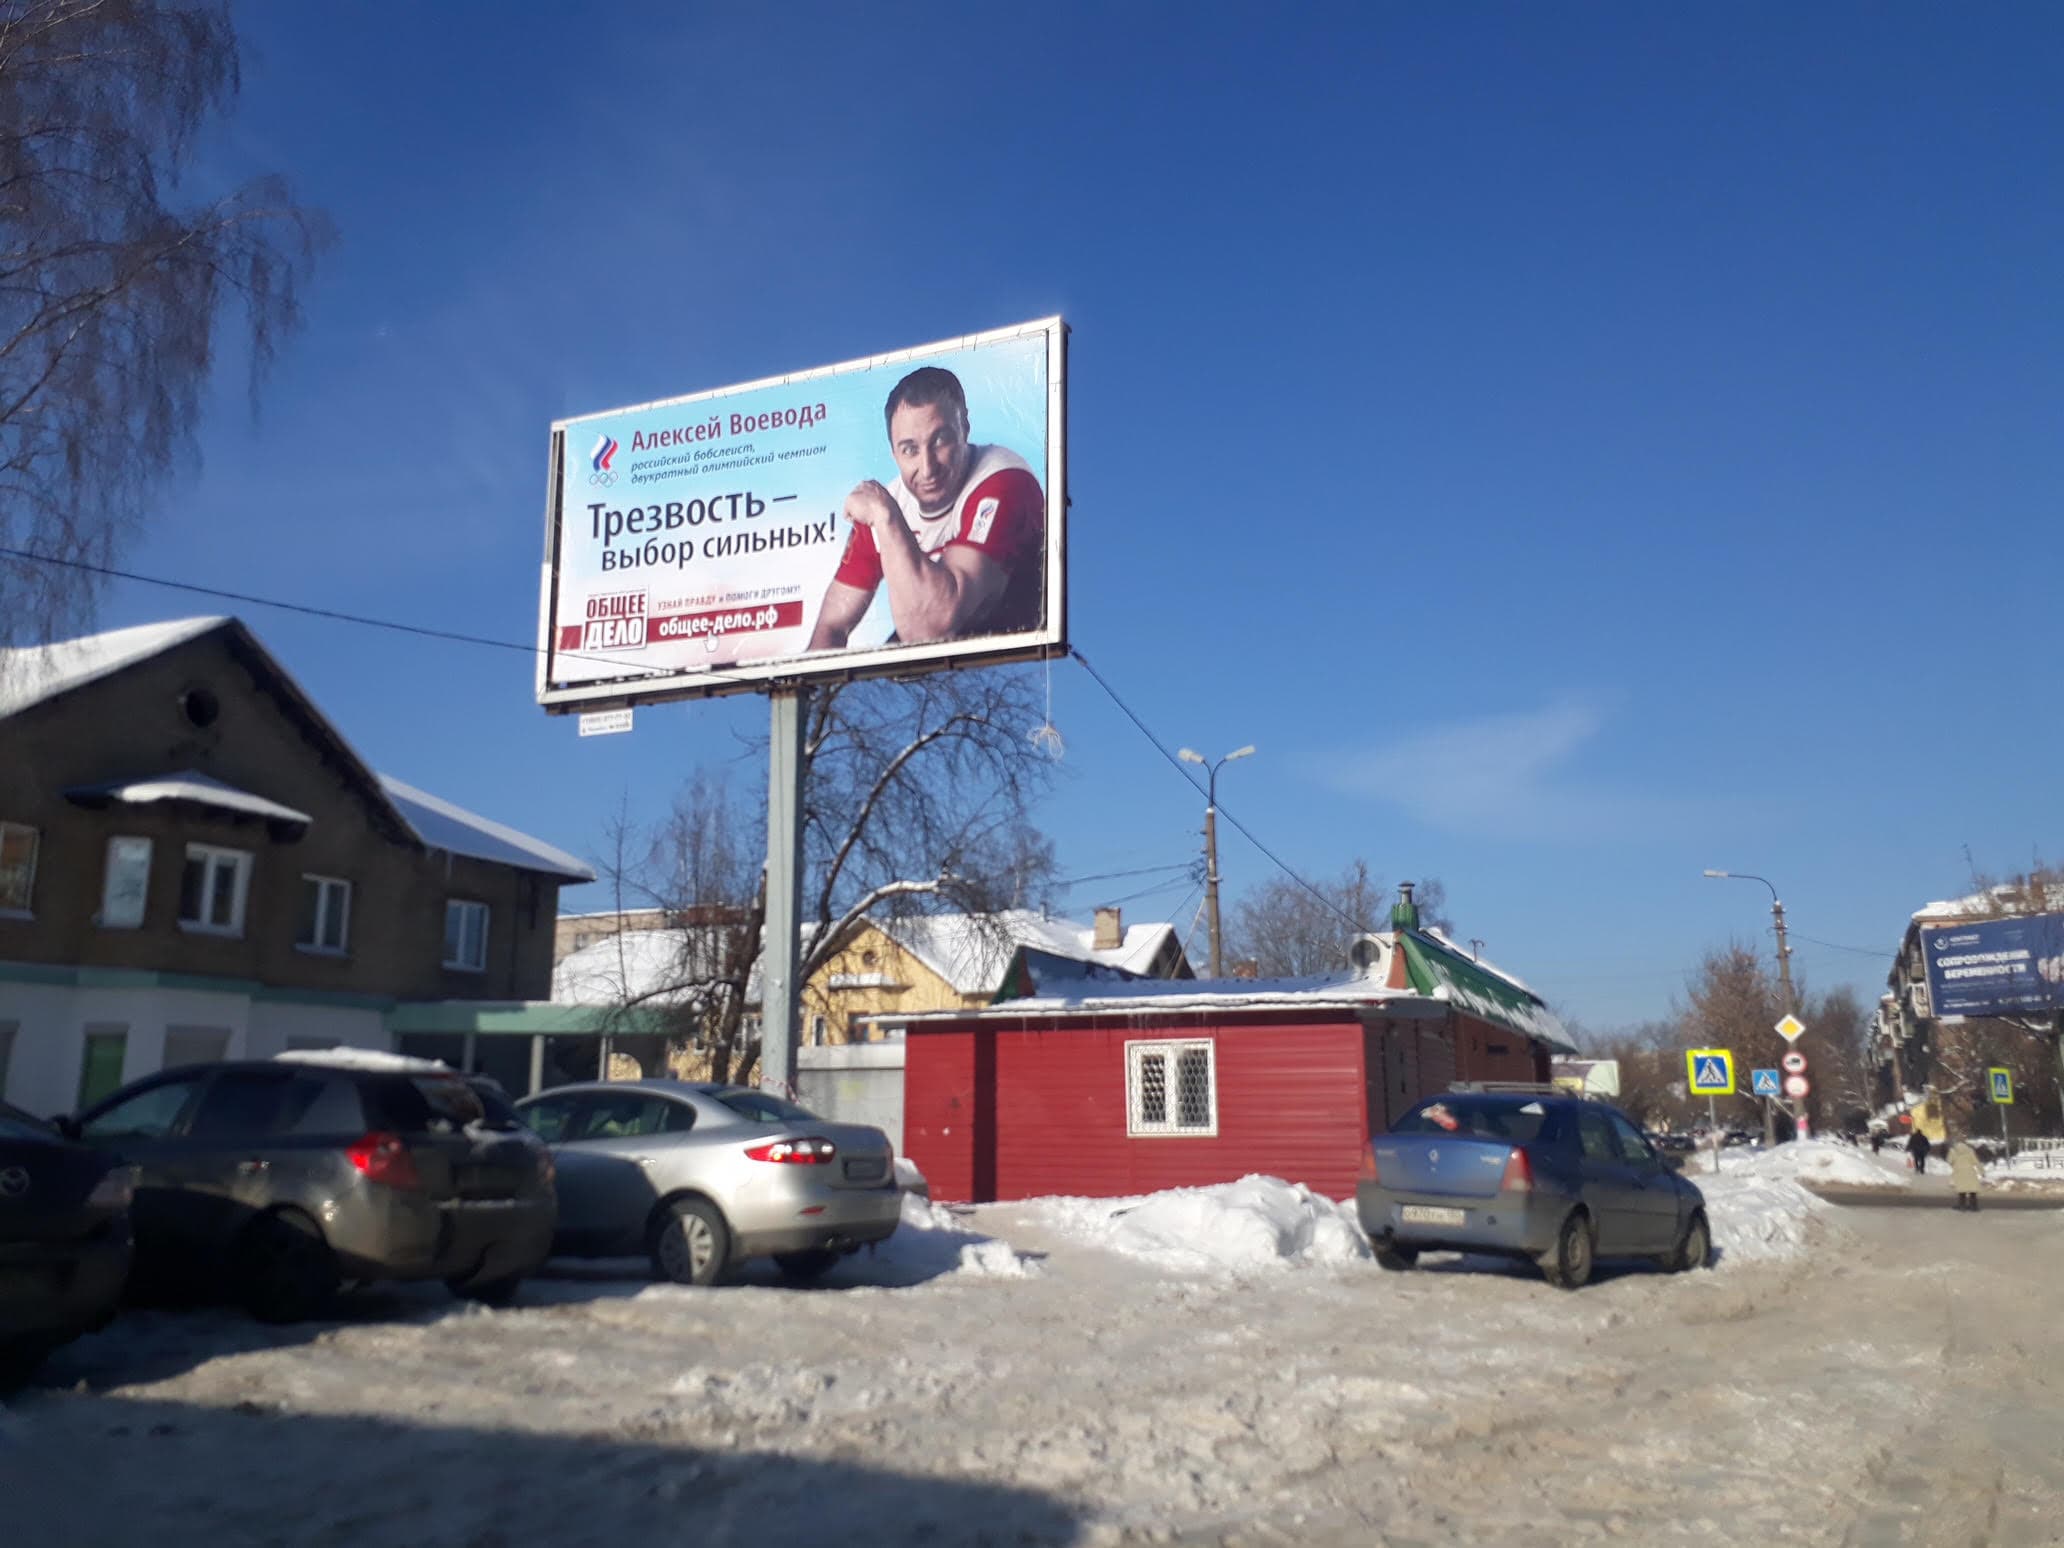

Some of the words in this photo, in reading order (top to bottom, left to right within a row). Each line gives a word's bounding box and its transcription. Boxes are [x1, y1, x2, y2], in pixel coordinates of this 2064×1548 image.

[631, 416, 722, 452] Алексей
[729, 402, 828, 436] Воевода
[630, 452, 691, 475] российский
[693, 443, 756, 463] бобслеист,
[630, 464, 699, 485] двукратный
[701, 452, 775, 475] олимпийский
[777, 445, 828, 462] чемпион
[587, 491, 766, 547] Трезвость
[601, 536, 694, 572] выбор
[702, 511, 836, 559] сильных!
[586, 592, 647, 621] ОБЩЕЕ
[656, 598, 683, 612] УЗНАЙ
[684, 594, 716, 609] ПРАВДУ
[725, 589, 759, 602] ПОМОГИ
[584, 617, 645, 651] ДЕЛО
[658, 605, 779, 637] общее-дело.рф
